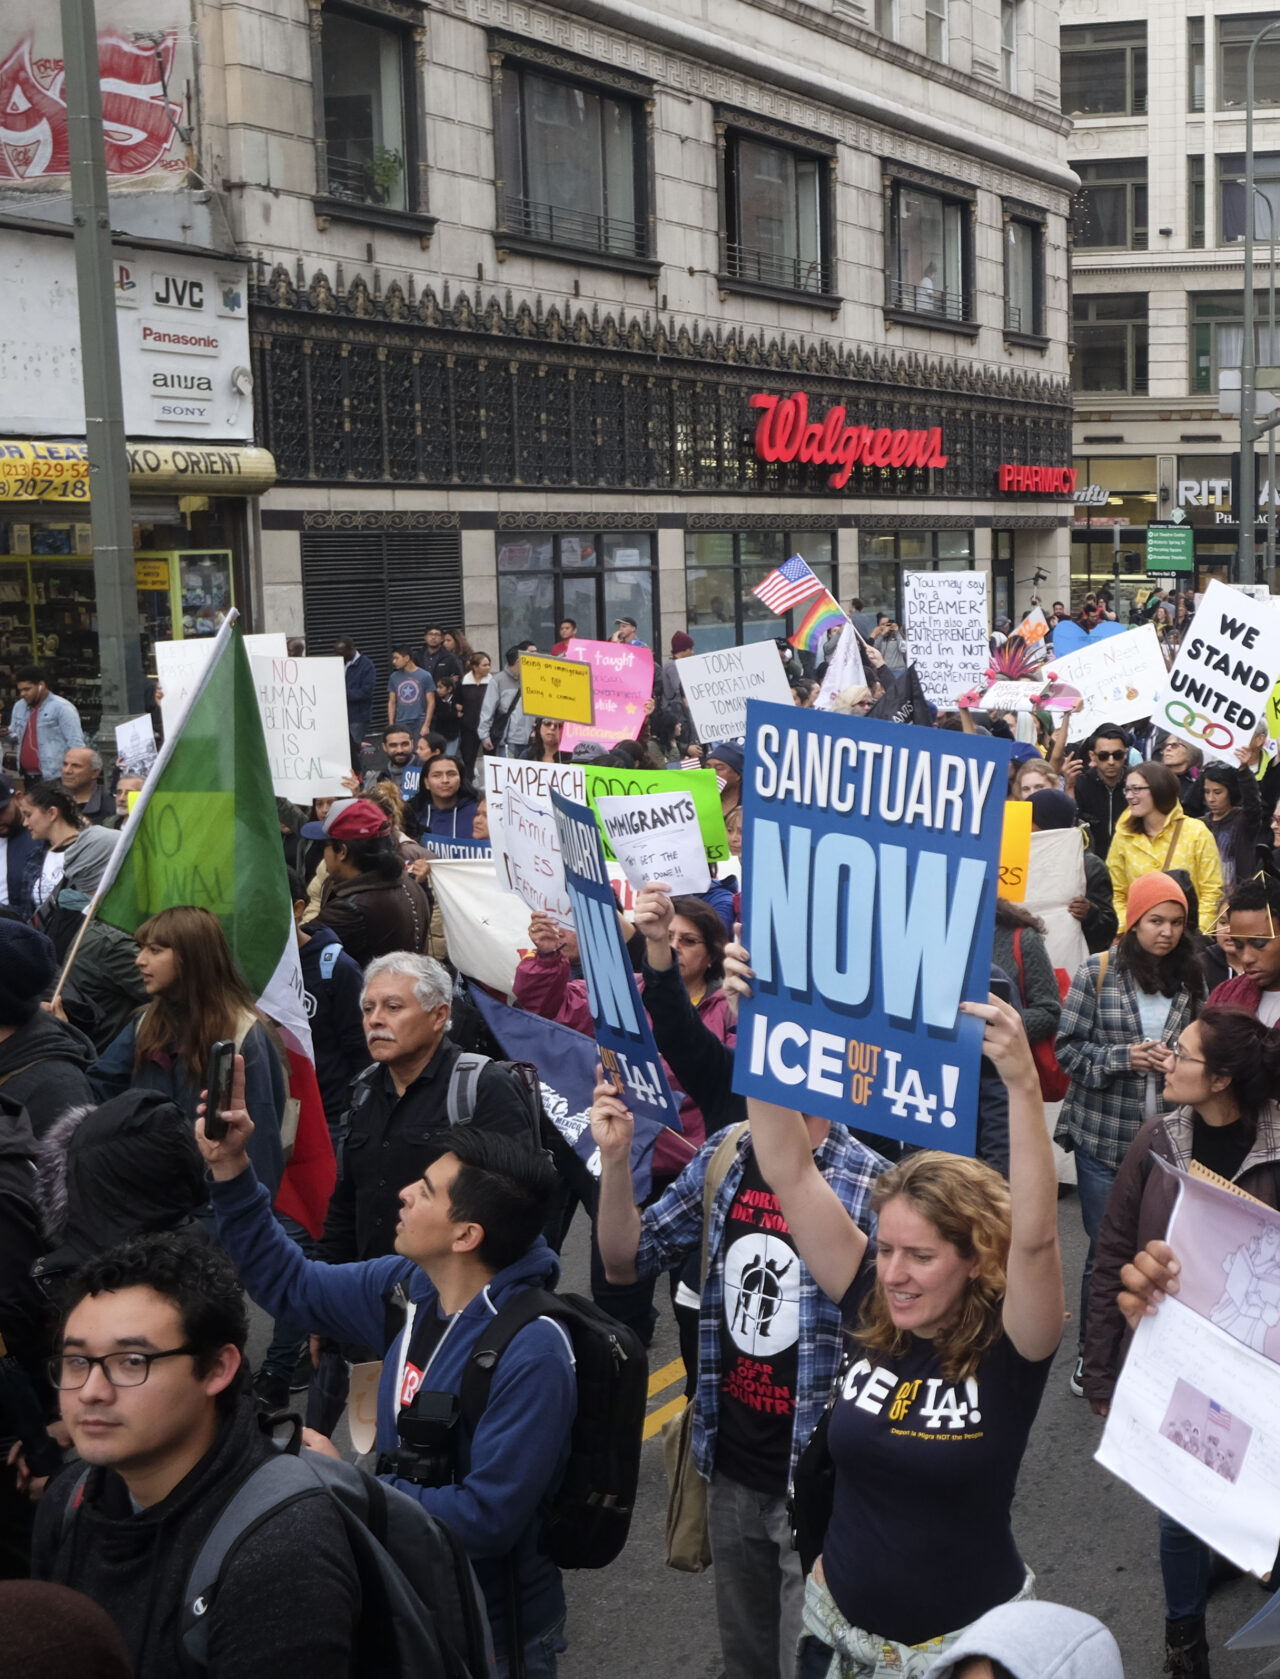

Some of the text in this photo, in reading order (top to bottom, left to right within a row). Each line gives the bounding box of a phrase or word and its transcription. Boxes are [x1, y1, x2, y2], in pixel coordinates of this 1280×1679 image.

[155, 277, 204, 308] JVC
[142, 326, 219, 349] Panasonic
[152, 372, 213, 391] aiwa
[161, 405, 207, 417] SONY
[749, 391, 949, 490] Walgreens
[172, 450, 242, 475] ORIENT
[998, 464, 1078, 493] PHARMACY
[1178, 479, 1233, 506] RIT
[915, 575, 985, 595] You may say
[908, 600, 980, 615] DREAMER
[907, 627, 988, 641] ENTREPRENEUR
[944, 618, 962, 628] also
[968, 618, 980, 628] an
[1220, 613, 1260, 650] WE
[911, 643, 986, 656] and NOT
[272, 658, 299, 685] NO
[595, 651, 635, 672] taught
[702, 651, 744, 674] TODAY
[933, 661, 981, 672] only one
[1187, 638, 1270, 693] STAND
[259, 684, 316, 706] HUMAN
[690, 672, 766, 701] DEPORTATION
[920, 682, 949, 694] DACA
[1170, 669, 1256, 731] UNITED
[264, 706, 317, 731] BEING
[281, 733, 301, 757] IS
[489, 764, 584, 800] IMPEACH
[755, 723, 996, 835] SANCTUARY
[605, 798, 696, 839] IMMIGRANTS
[660, 850, 679, 862] THE
[750, 817, 987, 1029] NOW
[749, 1013, 960, 1129] ICE OUT OF LA!
[555, 1116, 582, 1131] MEXICO
[731, 1203, 756, 1223] DEL
[737, 1357, 773, 1375] FEAR
[738, 1365, 773, 1385] OF A
[842, 1358, 899, 1415] CE
[889, 1400, 912, 1421] OF
[964, 1431, 984, 1440] People
